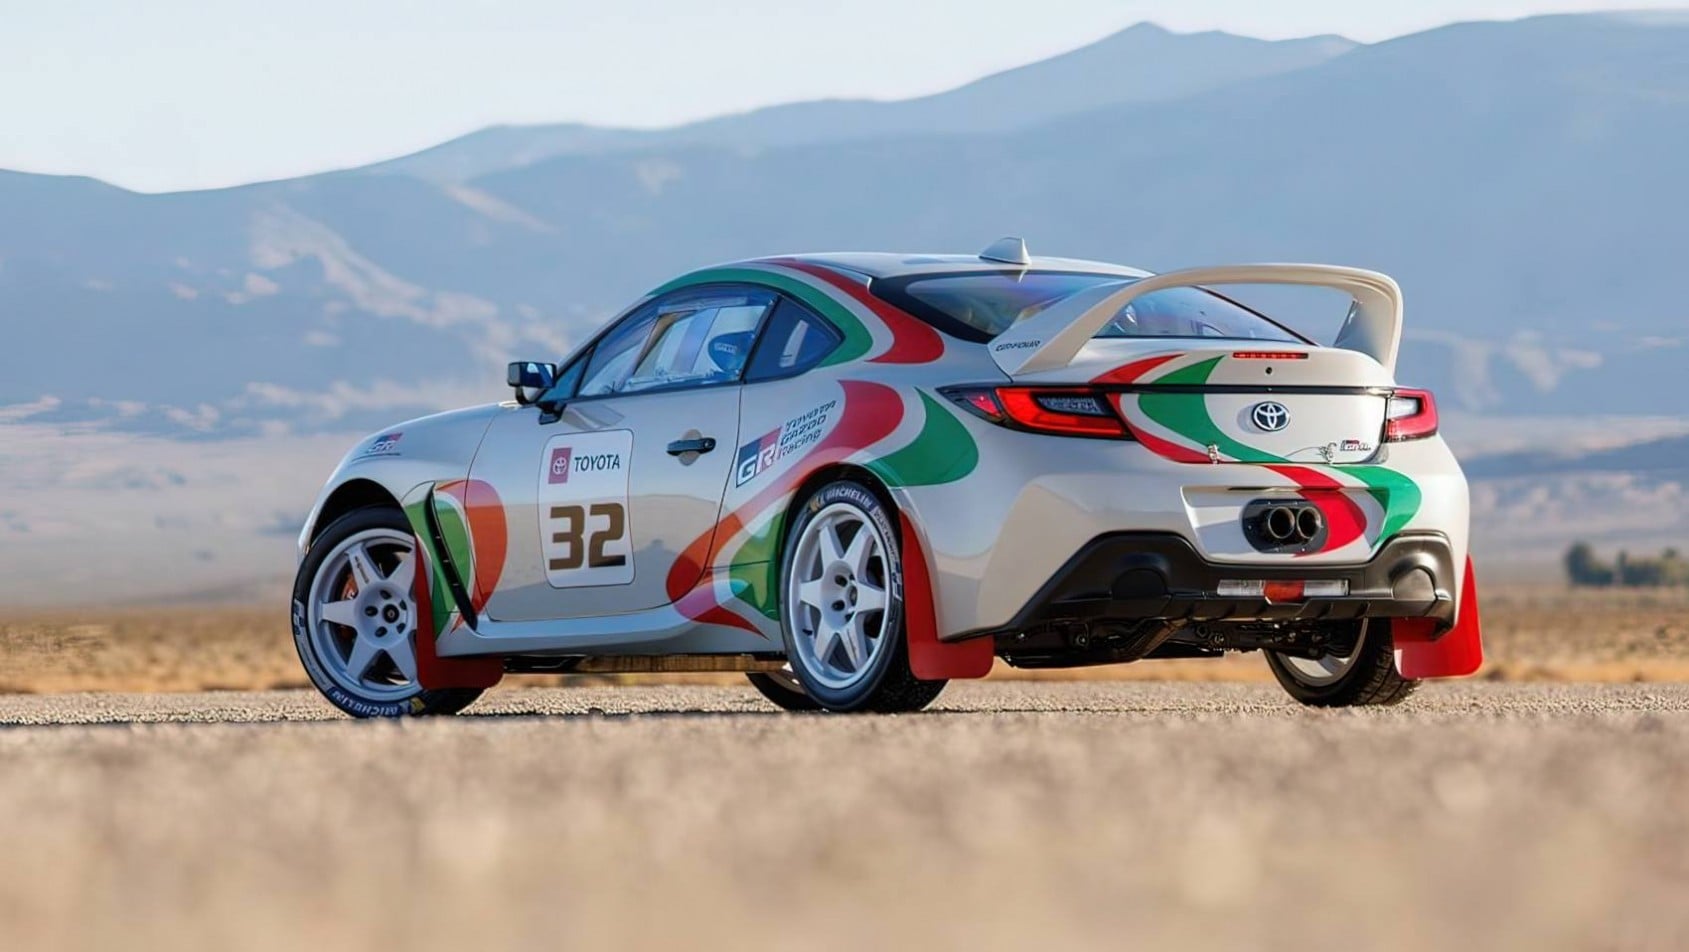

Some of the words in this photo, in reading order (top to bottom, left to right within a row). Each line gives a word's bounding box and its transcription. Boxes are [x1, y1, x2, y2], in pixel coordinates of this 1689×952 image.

[573, 454, 620, 473] TOYOTA
[736, 441, 777, 485] GR
[825, 486, 873, 509] MICHELIN
[549, 502, 626, 571] 32
